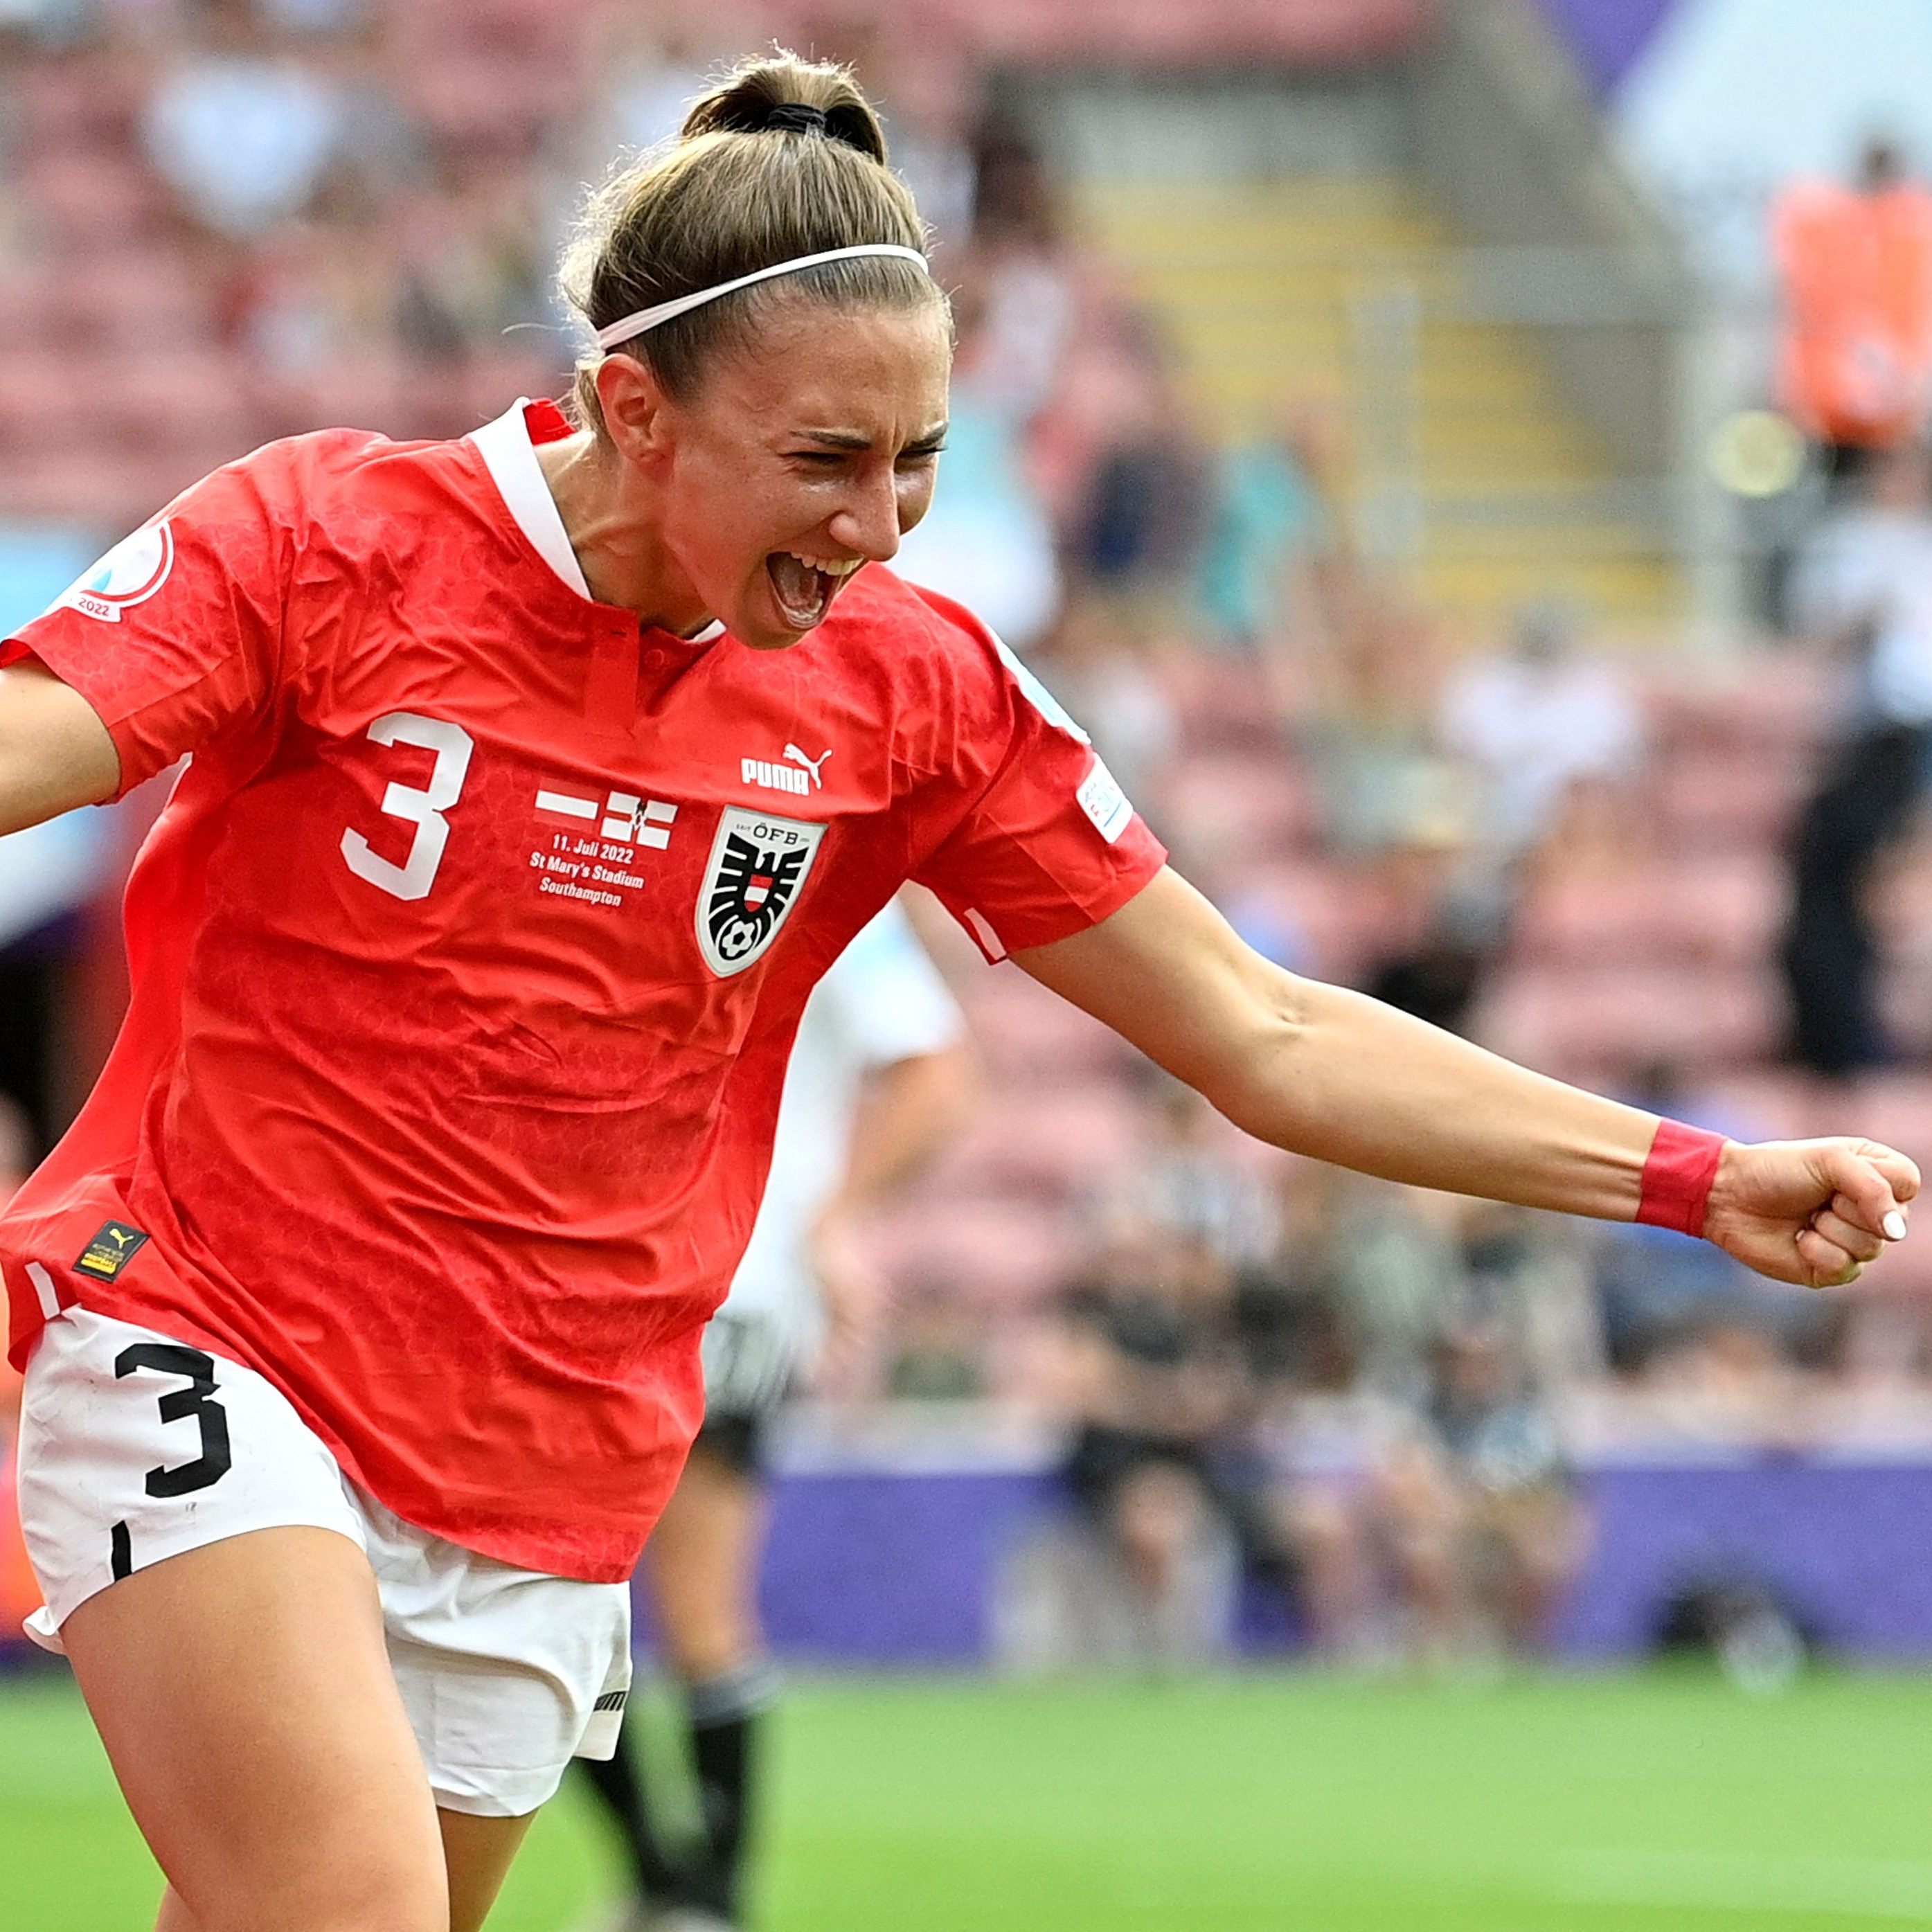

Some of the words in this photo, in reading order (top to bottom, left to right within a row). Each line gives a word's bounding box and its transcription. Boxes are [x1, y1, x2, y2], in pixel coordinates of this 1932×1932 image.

[78, 597, 110, 617] 2022
[741, 758, 810, 796] PUMA
[339, 711, 475, 901] 3
[553, 834, 571, 852] 11.
[573, 838, 600, 857] Juli
[600, 843, 634, 865] 2022
[753, 822, 799, 846] ÖFB
[529, 851, 546, 869] St
[547, 856, 591, 879] Mary's
[592, 865, 645, 889] Stadium
[539, 876, 623, 907] Southampton
[114, 1342, 232, 1499] 3
